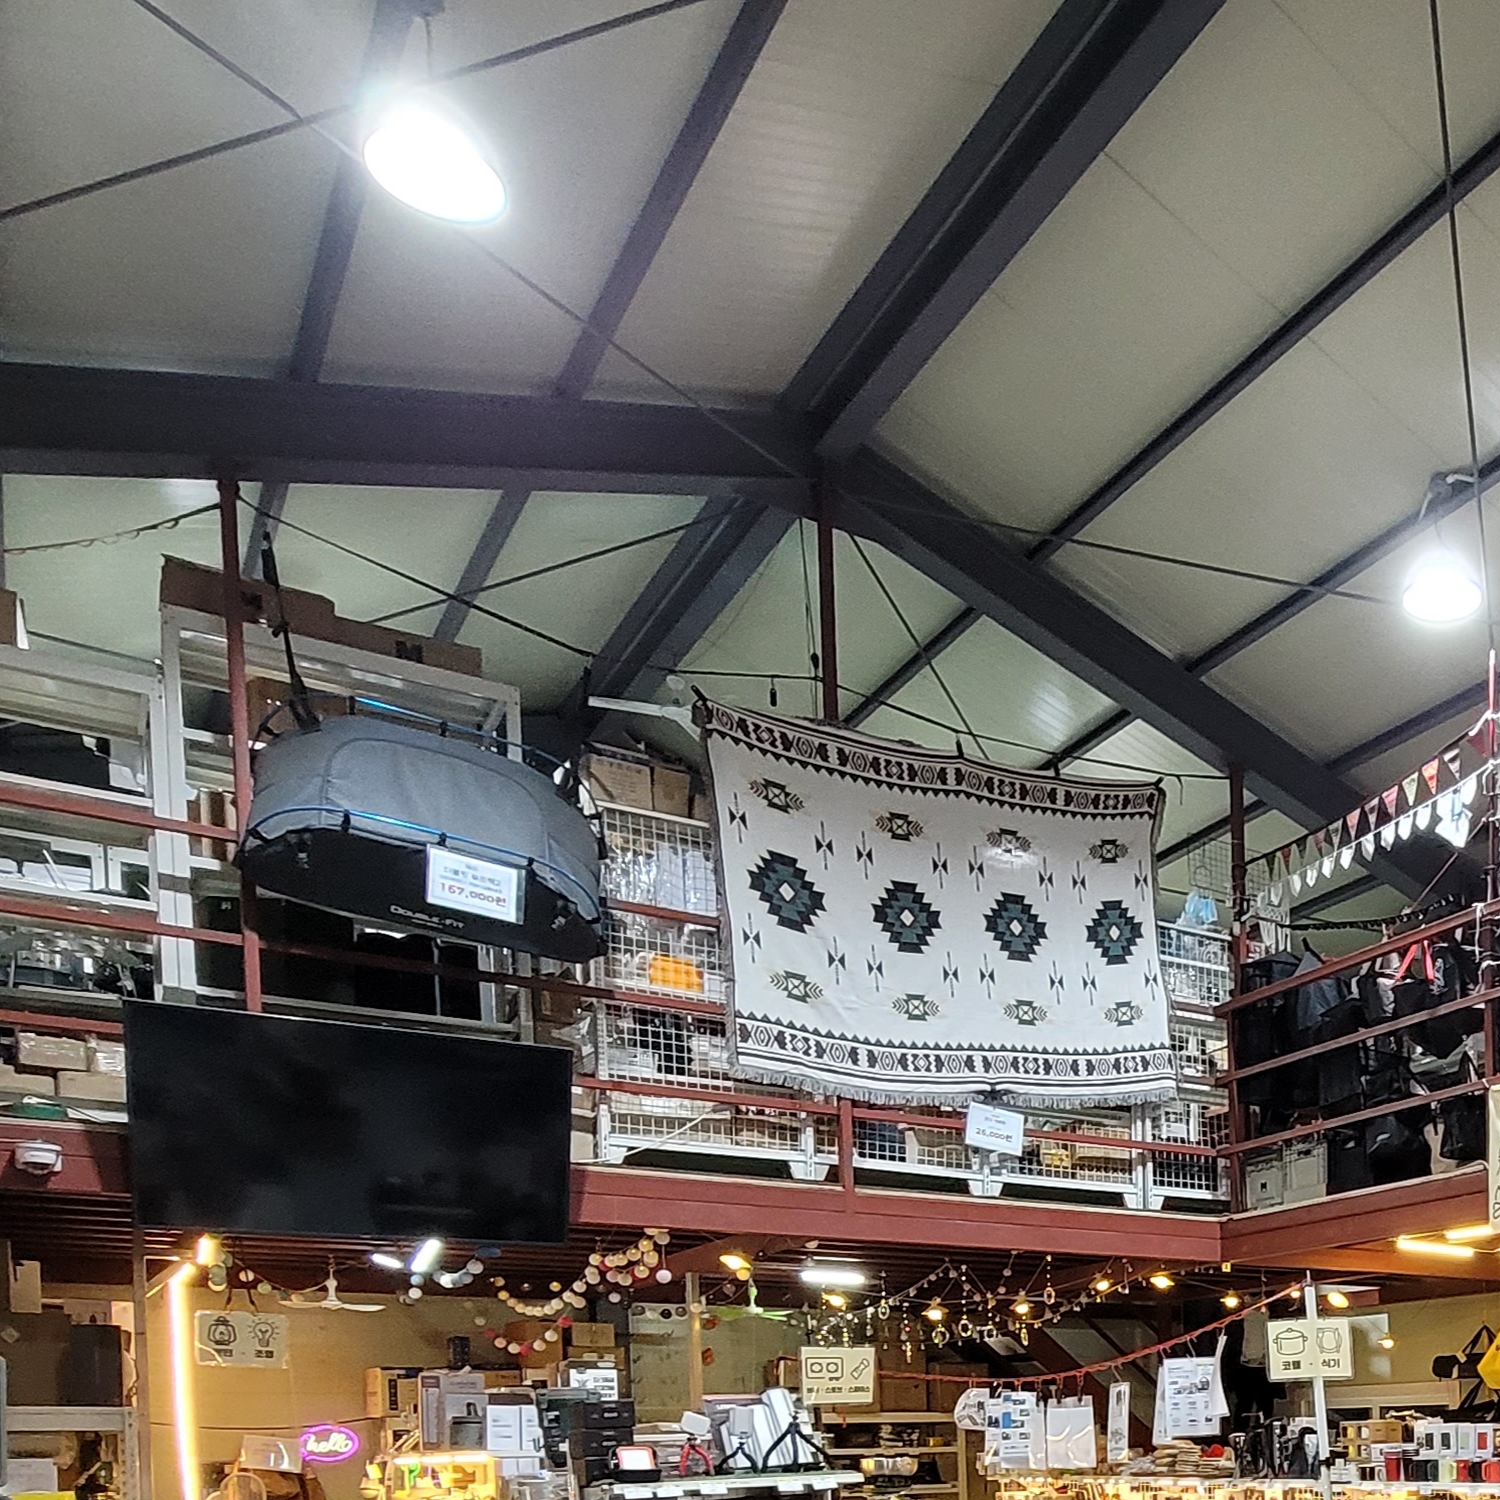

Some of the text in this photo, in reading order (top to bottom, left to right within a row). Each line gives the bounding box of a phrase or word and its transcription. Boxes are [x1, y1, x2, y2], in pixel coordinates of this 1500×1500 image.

[440, 882, 507, 908] 167,000원
[1321, 1358, 1340, 1369] 식기
[305, 1432, 353, 1453] hello
